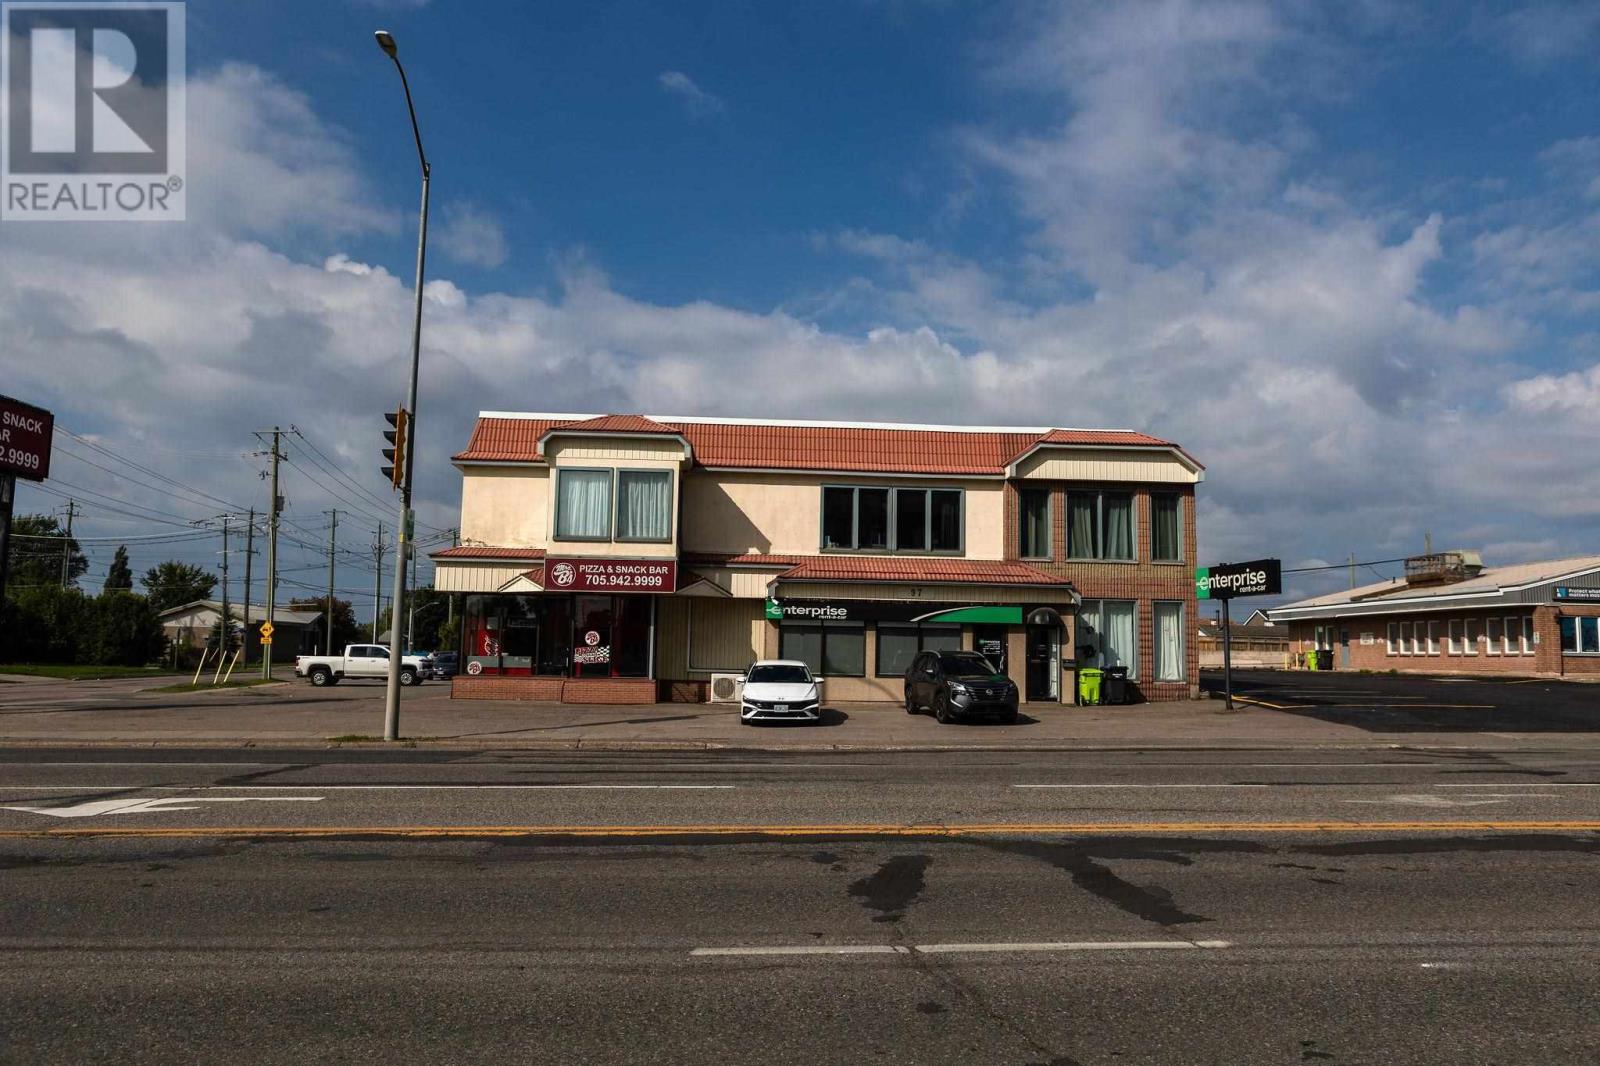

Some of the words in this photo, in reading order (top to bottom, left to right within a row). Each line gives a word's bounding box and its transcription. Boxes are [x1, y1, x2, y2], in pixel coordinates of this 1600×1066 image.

[3, 411, 43, 434] SNACK
[0, 428, 10, 443] R
[579, 564, 605, 573] PIZZA
[607, 565, 613, 573] &
[615, 565, 647, 574] SNACK
[649, 566, 669, 574] BAR
[585, 574, 662, 586] 705.942.9999
[1196, 568, 1266, 591] enterprise
[766, 605, 847, 618] enterprise
